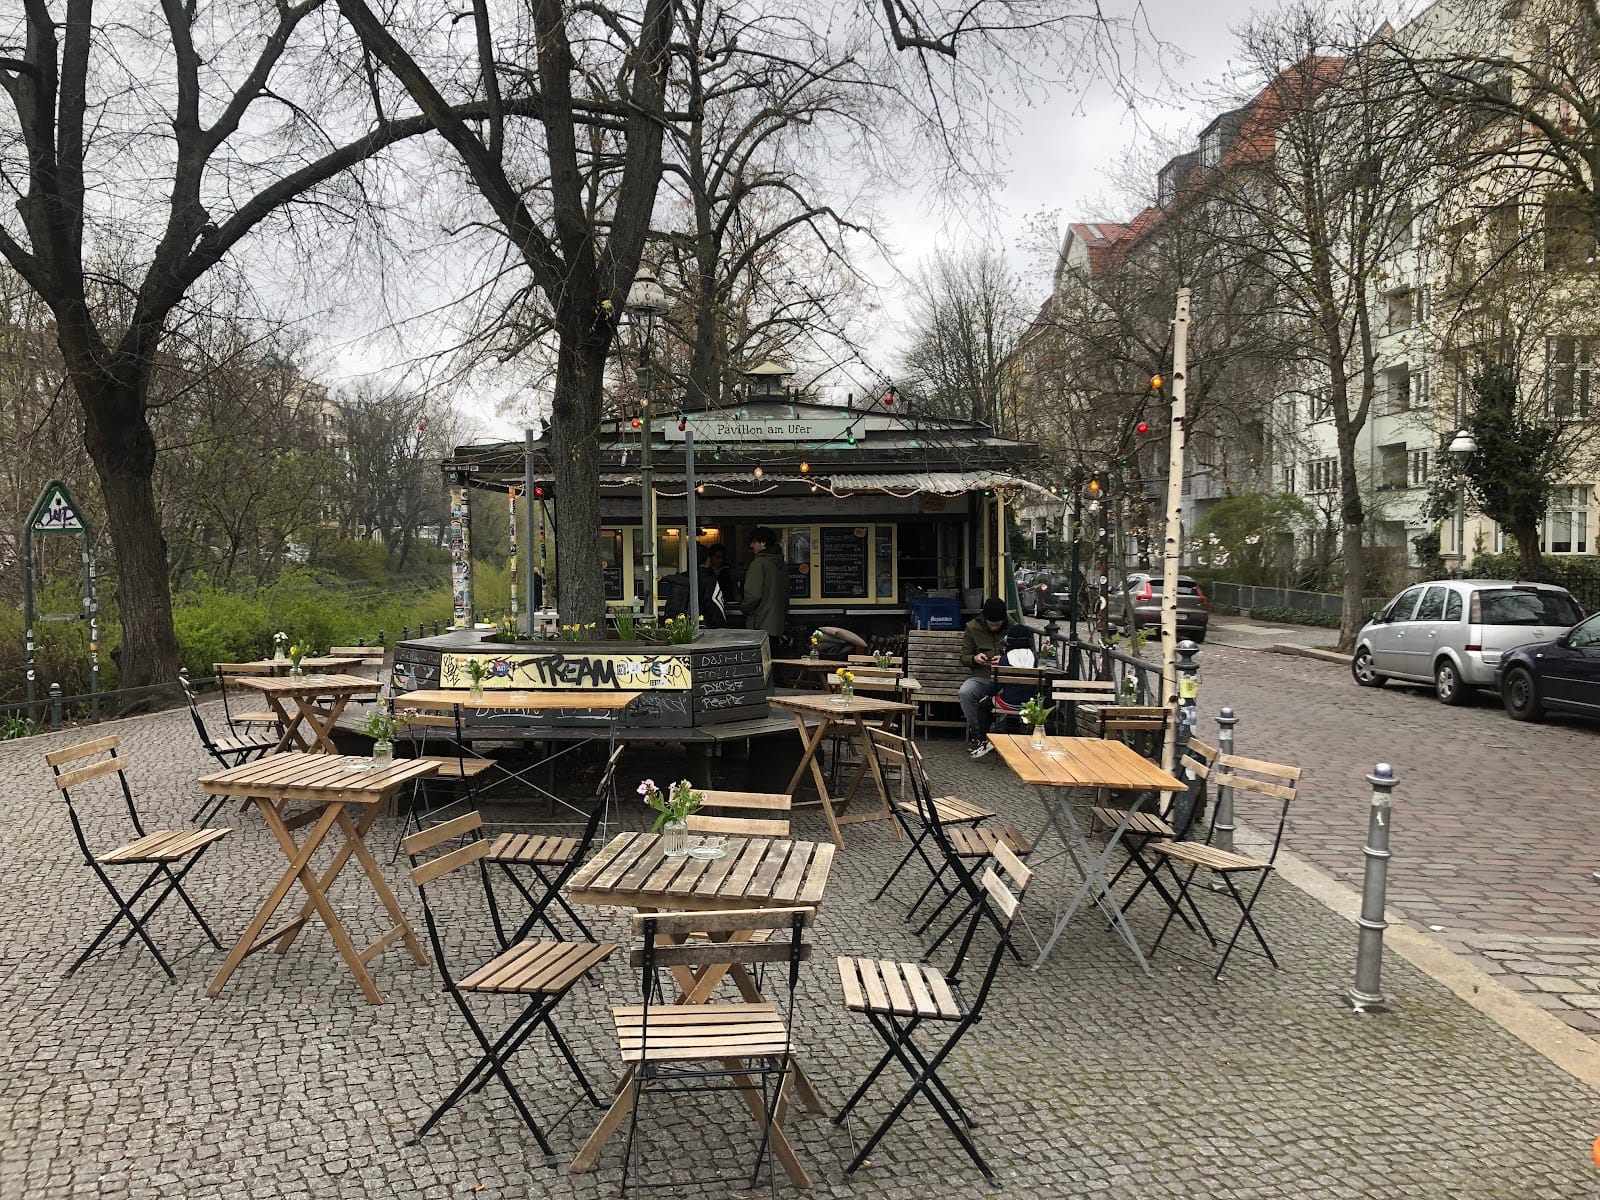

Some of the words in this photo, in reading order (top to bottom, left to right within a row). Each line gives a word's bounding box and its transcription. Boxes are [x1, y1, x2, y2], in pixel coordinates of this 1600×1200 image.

[717, 424, 763, 435] Pavillon
[767, 426, 784, 434] am
[788, 424, 813, 434] Ufer
